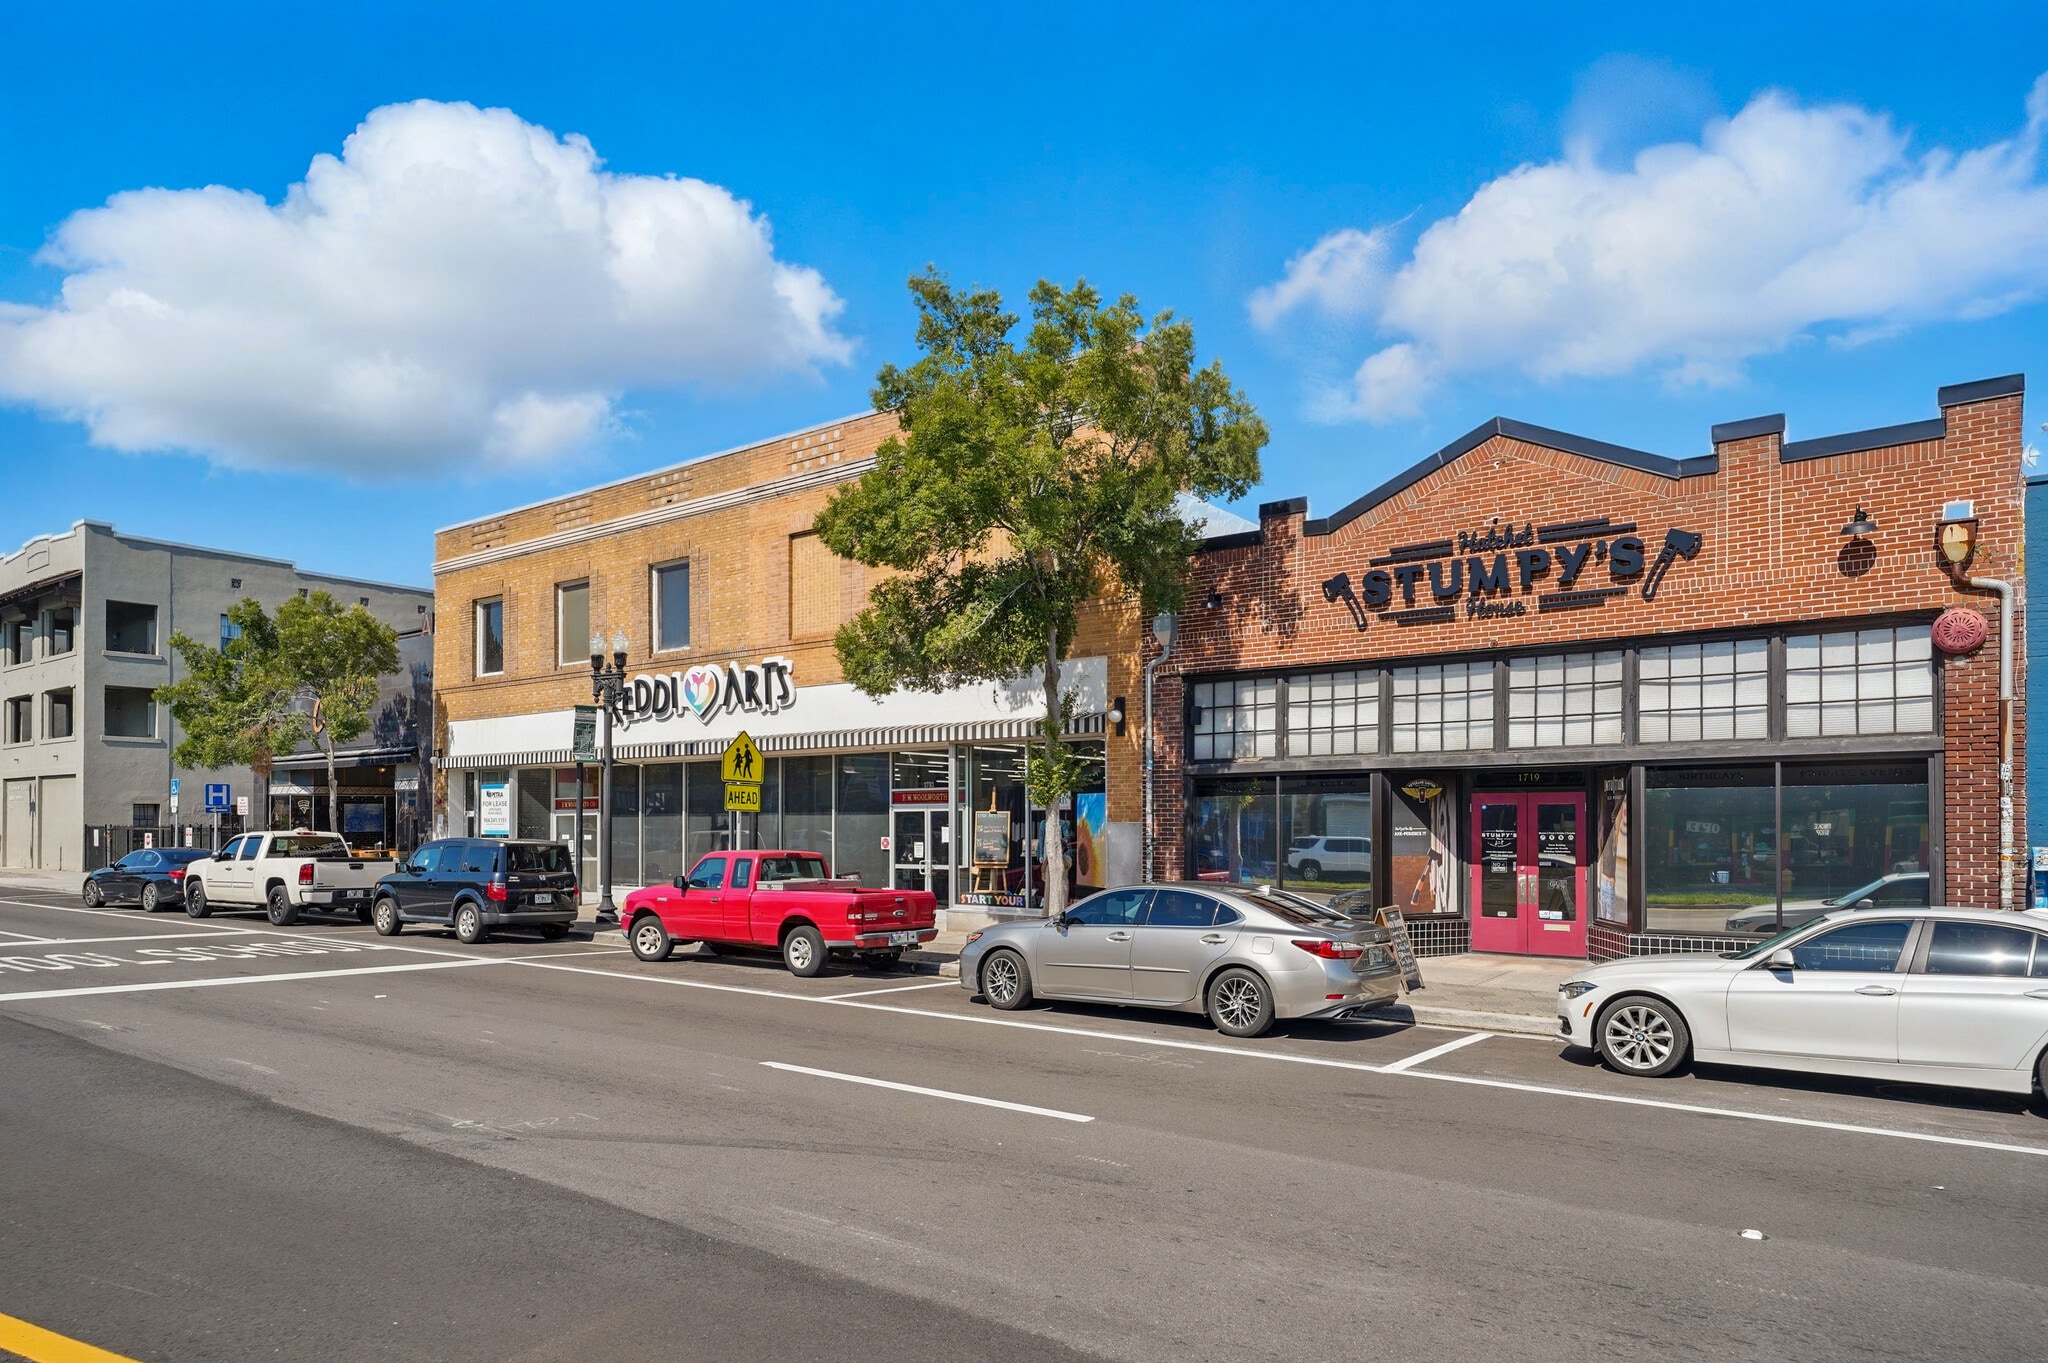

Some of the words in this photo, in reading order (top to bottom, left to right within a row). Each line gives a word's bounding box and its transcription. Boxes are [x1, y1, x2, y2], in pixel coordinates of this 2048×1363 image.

[1457, 523, 1534, 554] Hatchet
[1362, 537, 1645, 604] STUMPY'S
[1466, 596, 1525, 621] House
[722, 661, 789, 707] ARTS
[1518, 772, 1540, 782] 1719
[208, 784, 228, 805] H
[727, 790, 758, 805] AHEAD
[913, 792, 948, 801] WOOLWORTH
[960, 894, 993, 905] START
[994, 895, 1024, 906] YOUR
